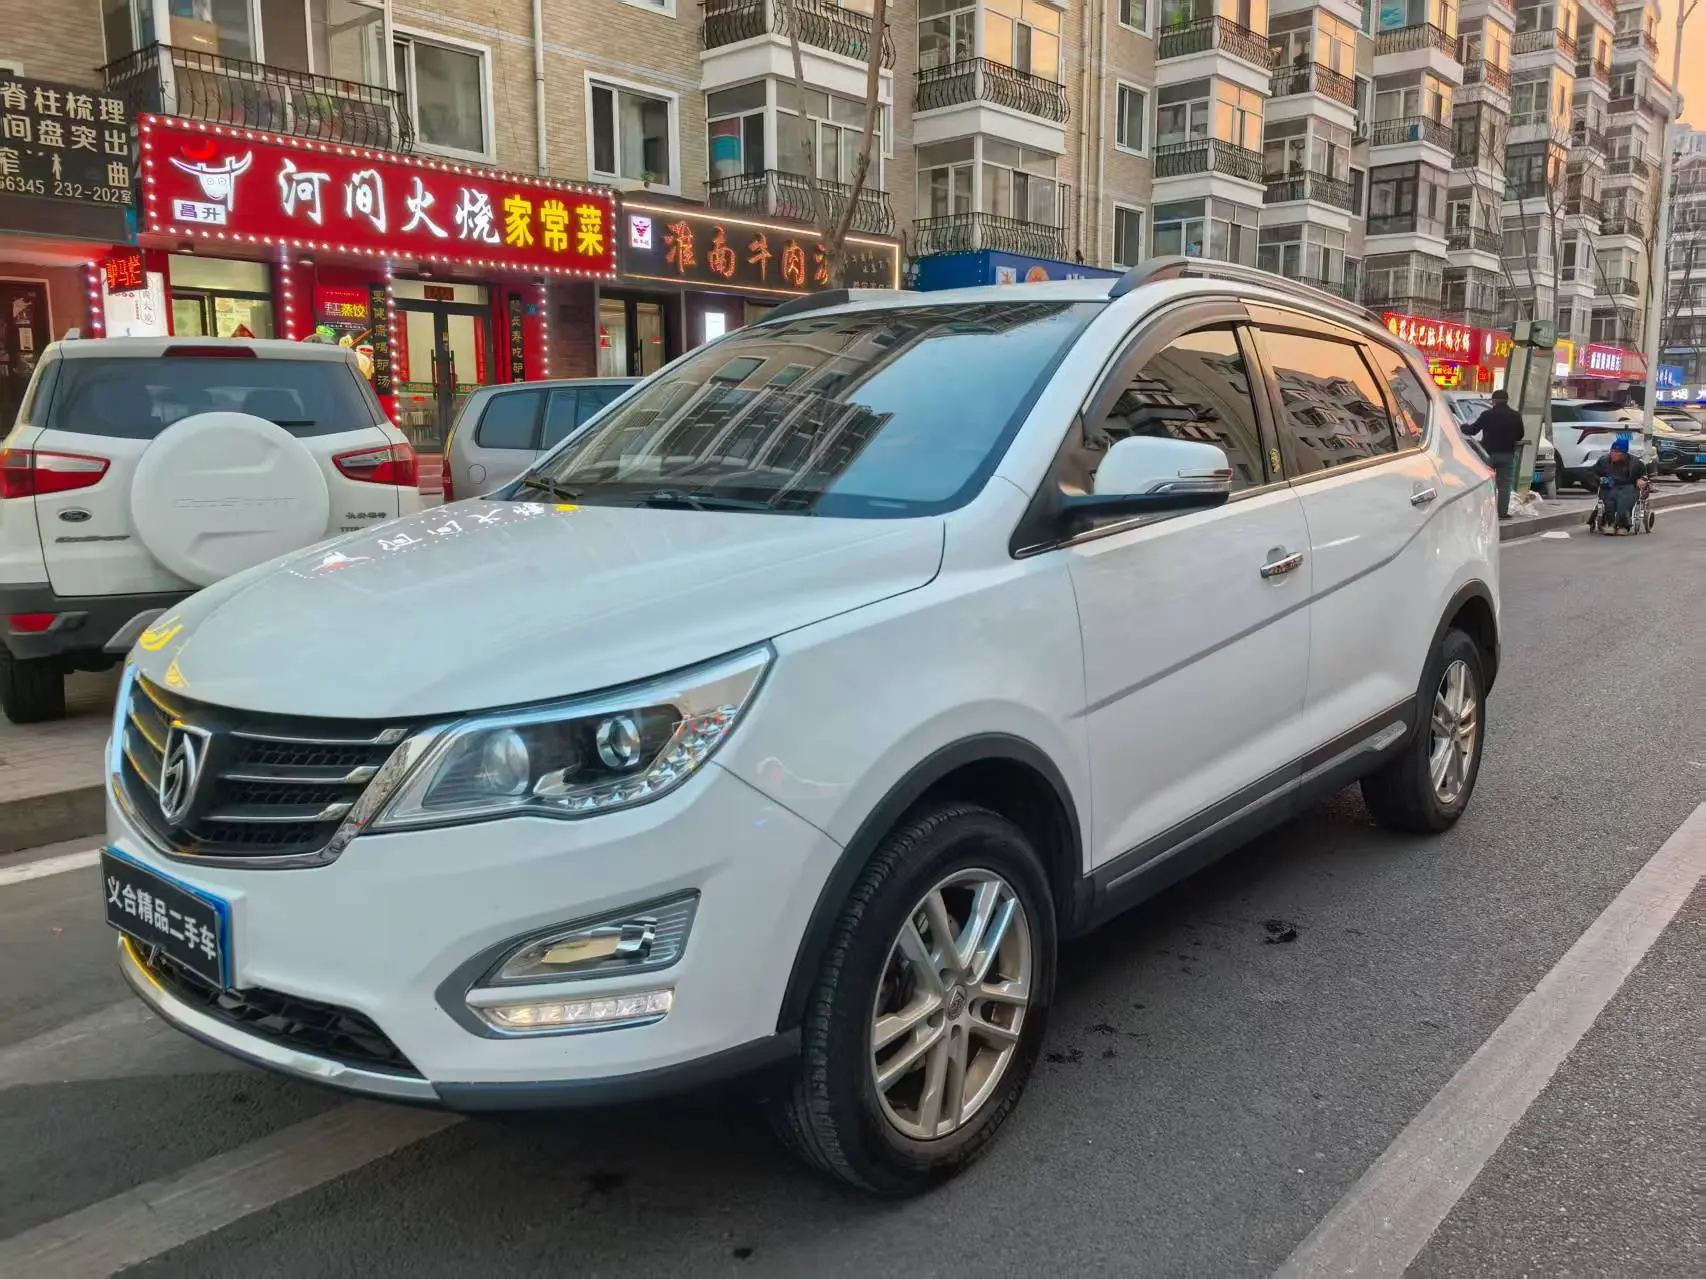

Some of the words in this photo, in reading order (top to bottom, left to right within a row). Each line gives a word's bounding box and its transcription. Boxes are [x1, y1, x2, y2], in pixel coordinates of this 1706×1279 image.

[0, 81, 126, 125] 脊柱梳理
[2, 113, 128, 156] 间盘突出
[54, 181, 132, 204] 232-202室
[180, 204, 220, 221] 昌升
[503, 193, 606, 256] 家常菜
[340, 302, 368, 319] 蒸饺
[107, 875, 216, 961] 义合精品二手车
